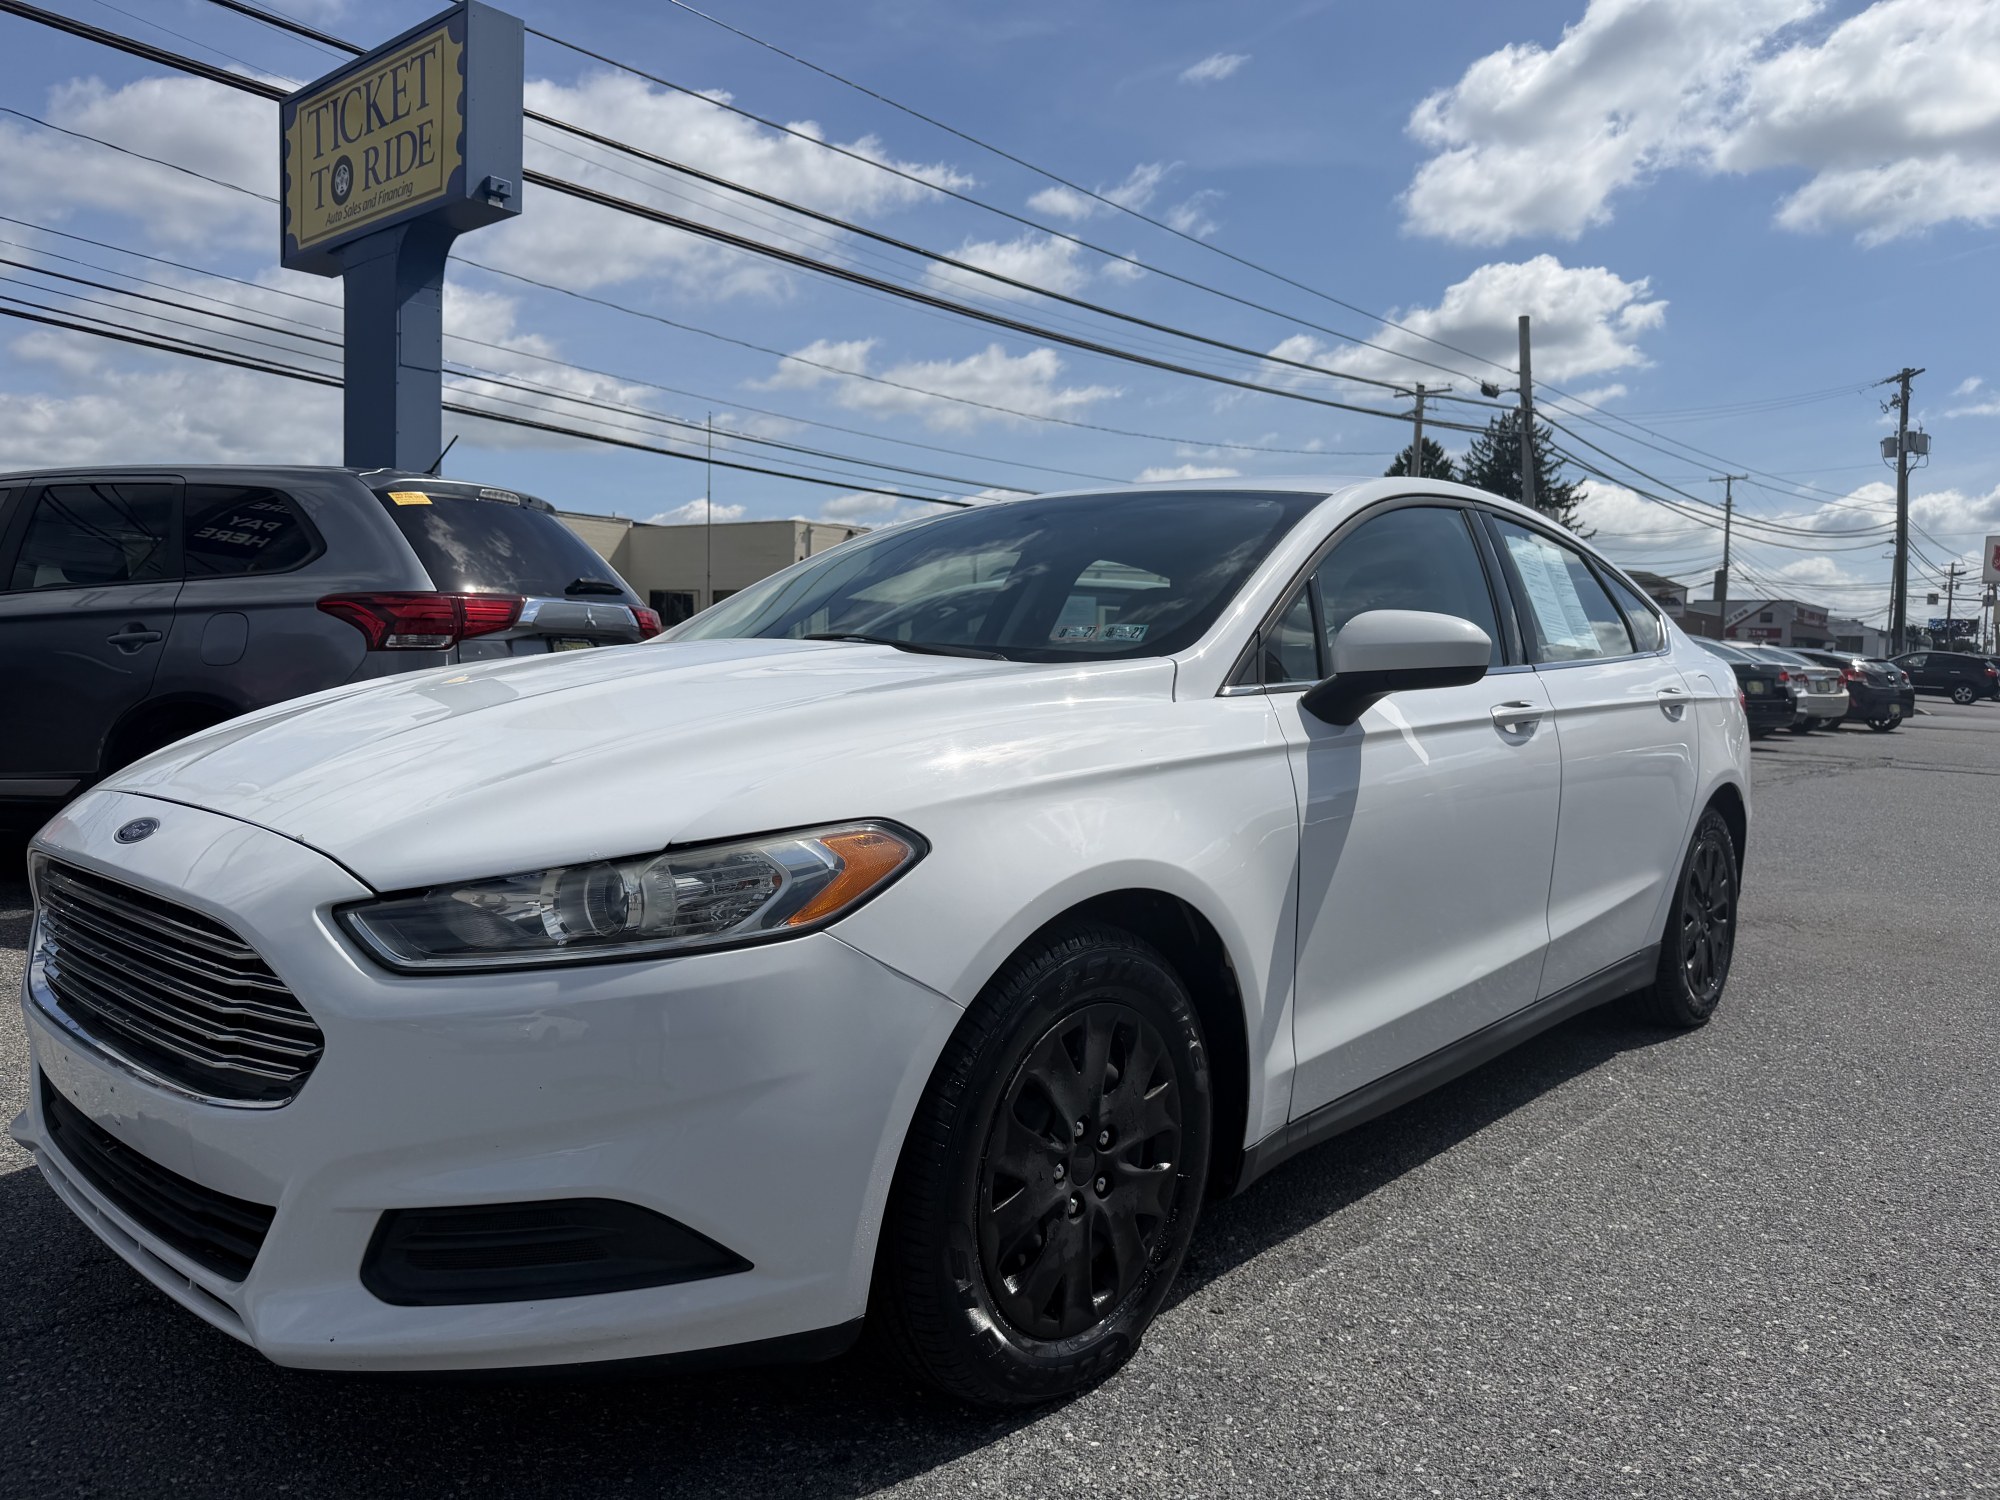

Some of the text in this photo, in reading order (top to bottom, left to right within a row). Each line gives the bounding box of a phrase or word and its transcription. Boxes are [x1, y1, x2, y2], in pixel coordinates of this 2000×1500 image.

[307, 45, 436, 160] TICKET
[310, 119, 435, 210] TO RIDE
[326, 180, 413, 227] Auto Sales and Financing
[1083, 626, 1097, 638] 27
[1130, 626, 1145, 639] 27
